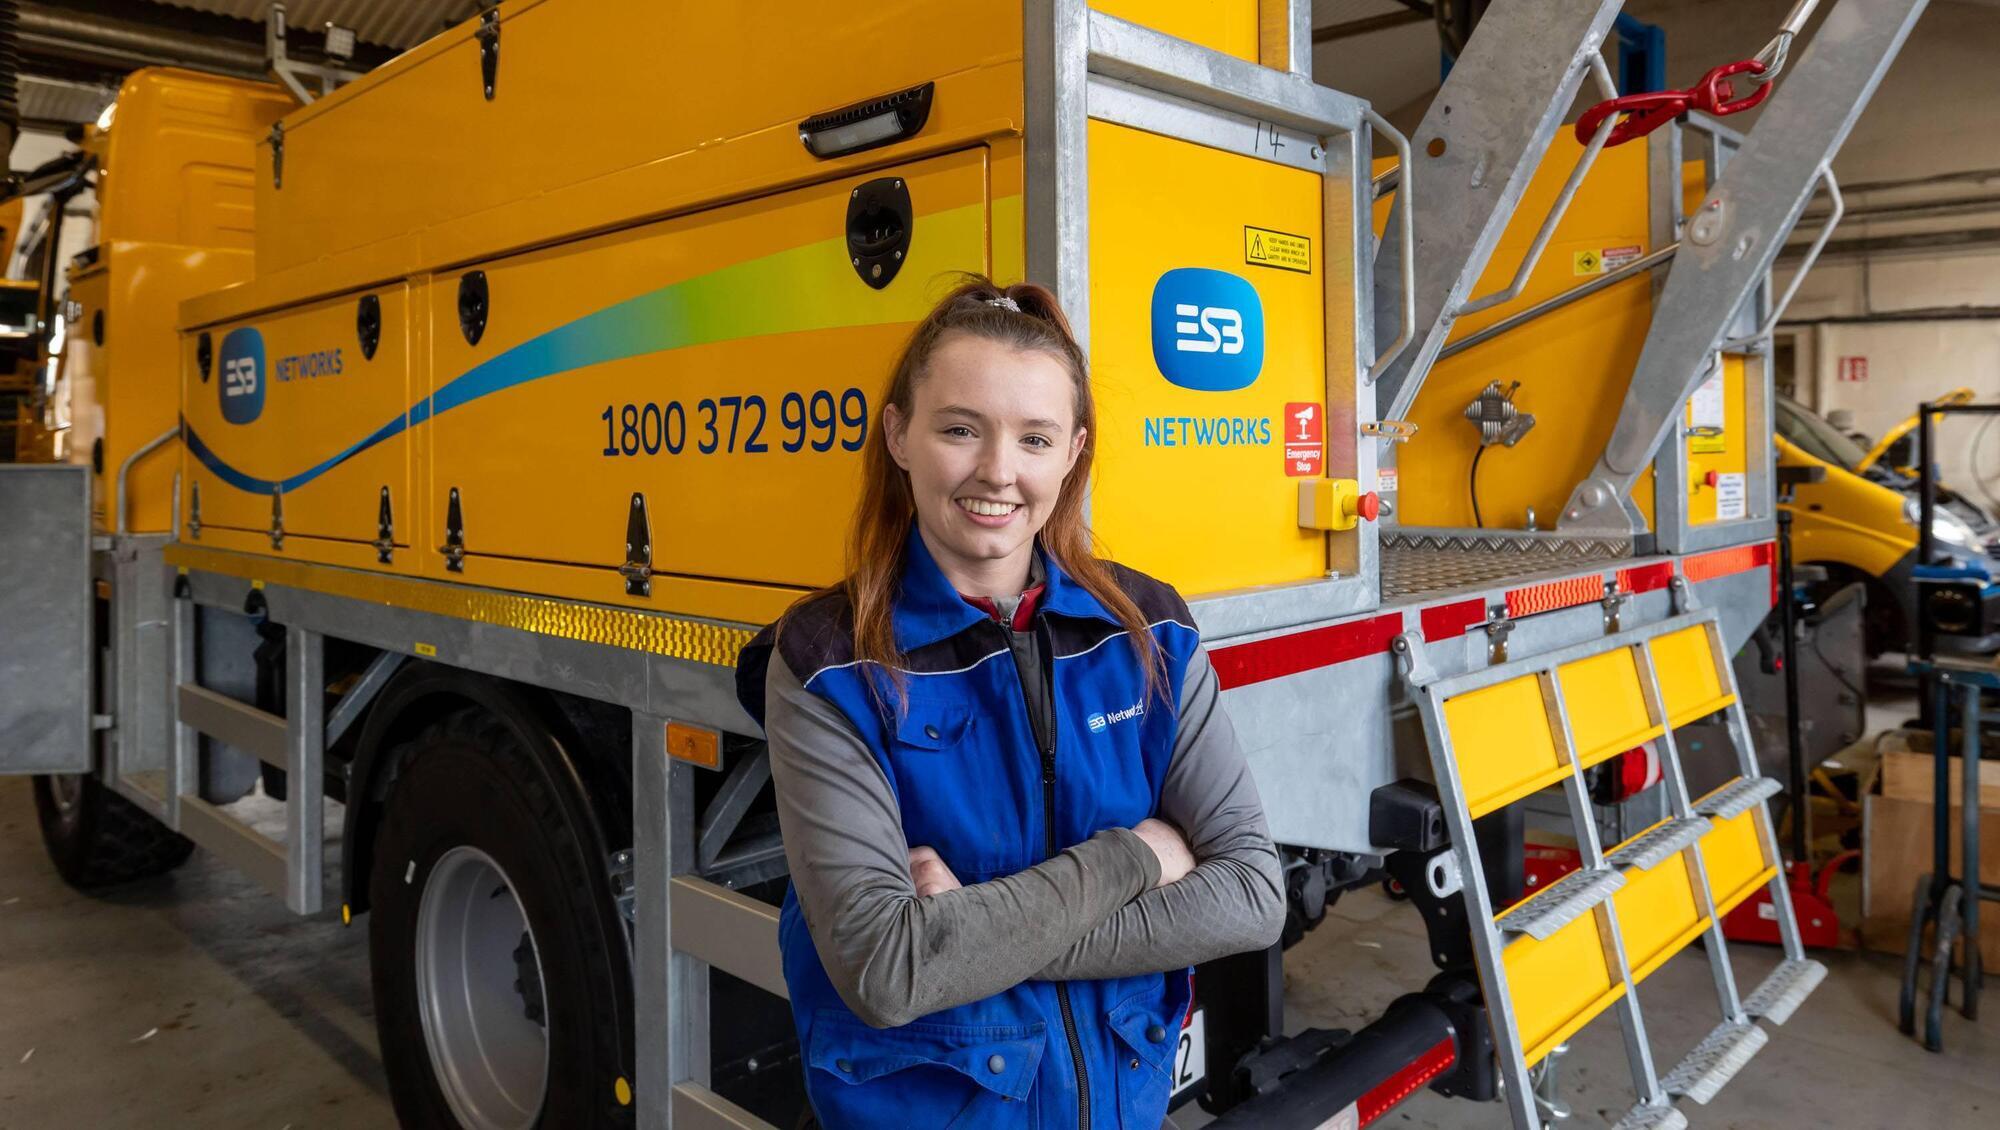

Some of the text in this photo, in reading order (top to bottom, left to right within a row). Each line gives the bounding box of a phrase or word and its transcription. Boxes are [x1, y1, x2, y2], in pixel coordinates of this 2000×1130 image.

[1254, 121, 1286, 158] 14
[1175, 303, 1245, 355] ESB
[226, 348, 343, 397] ESB NETWORKS
[601, 387, 868, 457] 1800 372 999
[1144, 417, 1271, 446] NETWORKS
[1286, 448, 1321, 461] Emergency
[1296, 460, 1312, 473] Stop
